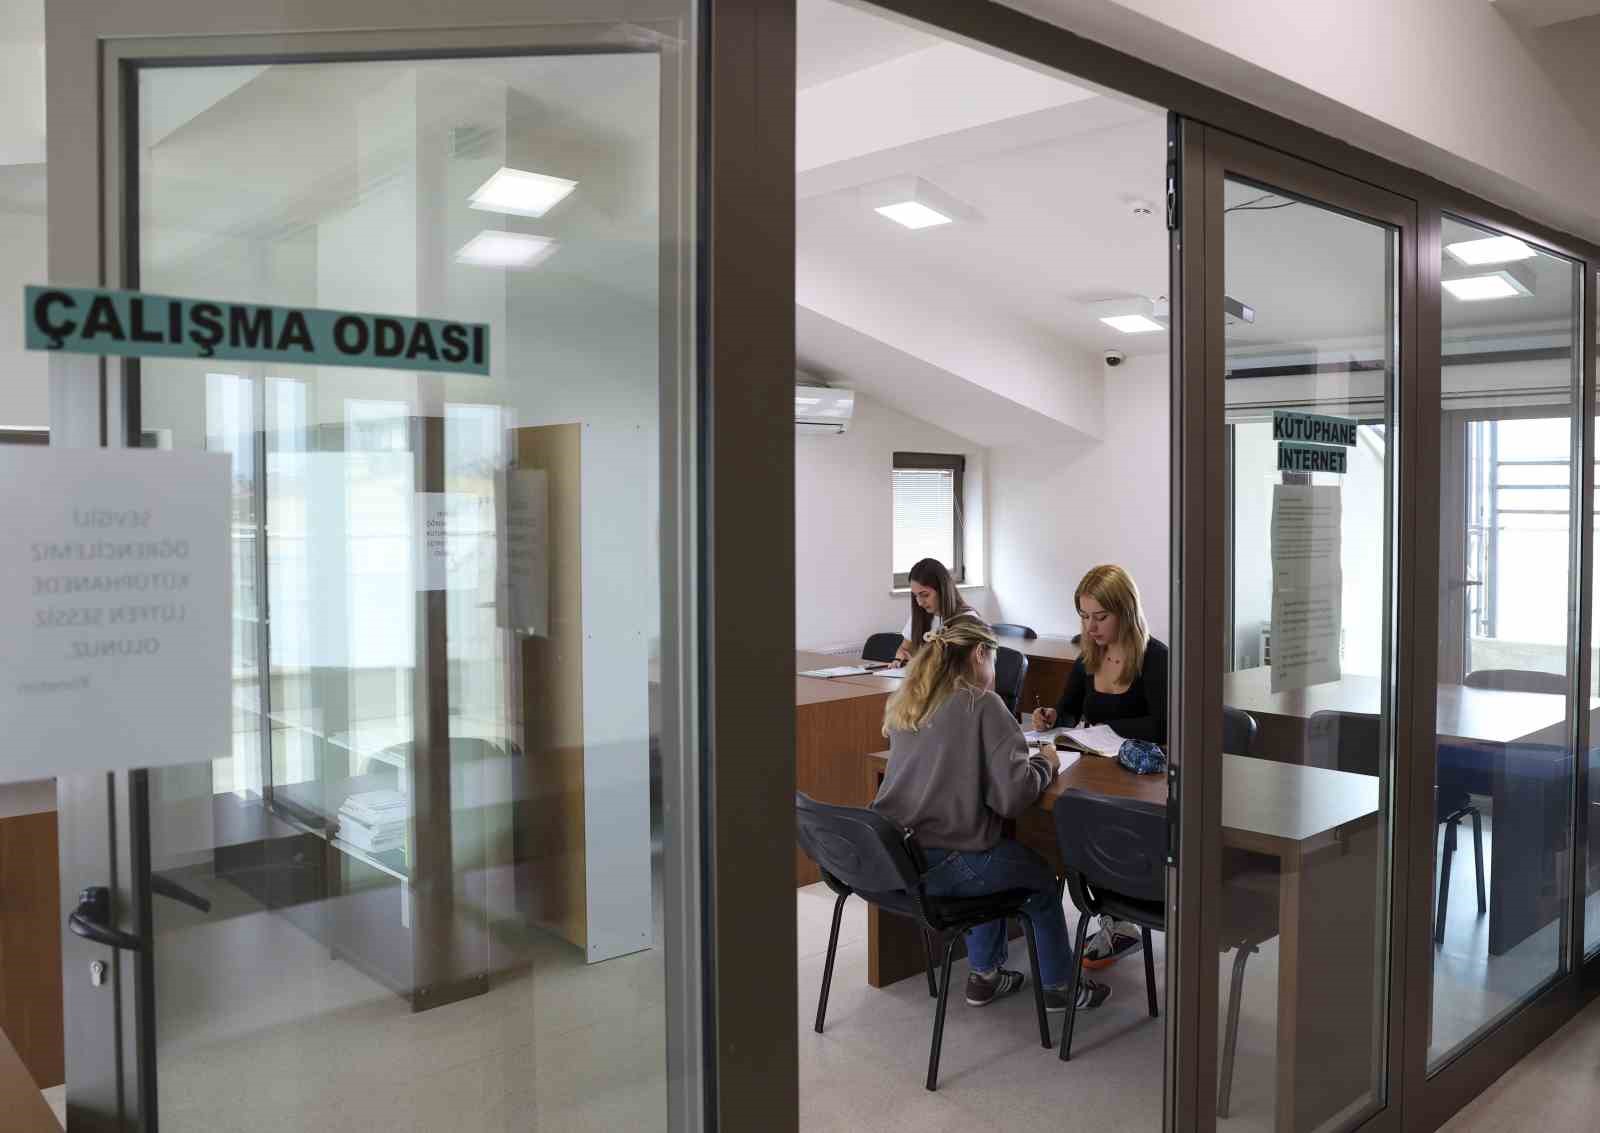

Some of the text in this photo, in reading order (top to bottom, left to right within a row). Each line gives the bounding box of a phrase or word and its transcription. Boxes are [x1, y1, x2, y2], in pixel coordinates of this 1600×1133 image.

[33, 291, 485, 365] ÇALIŞMA ODASI
[1273, 413, 1357, 445] KÜTÜPHANE
